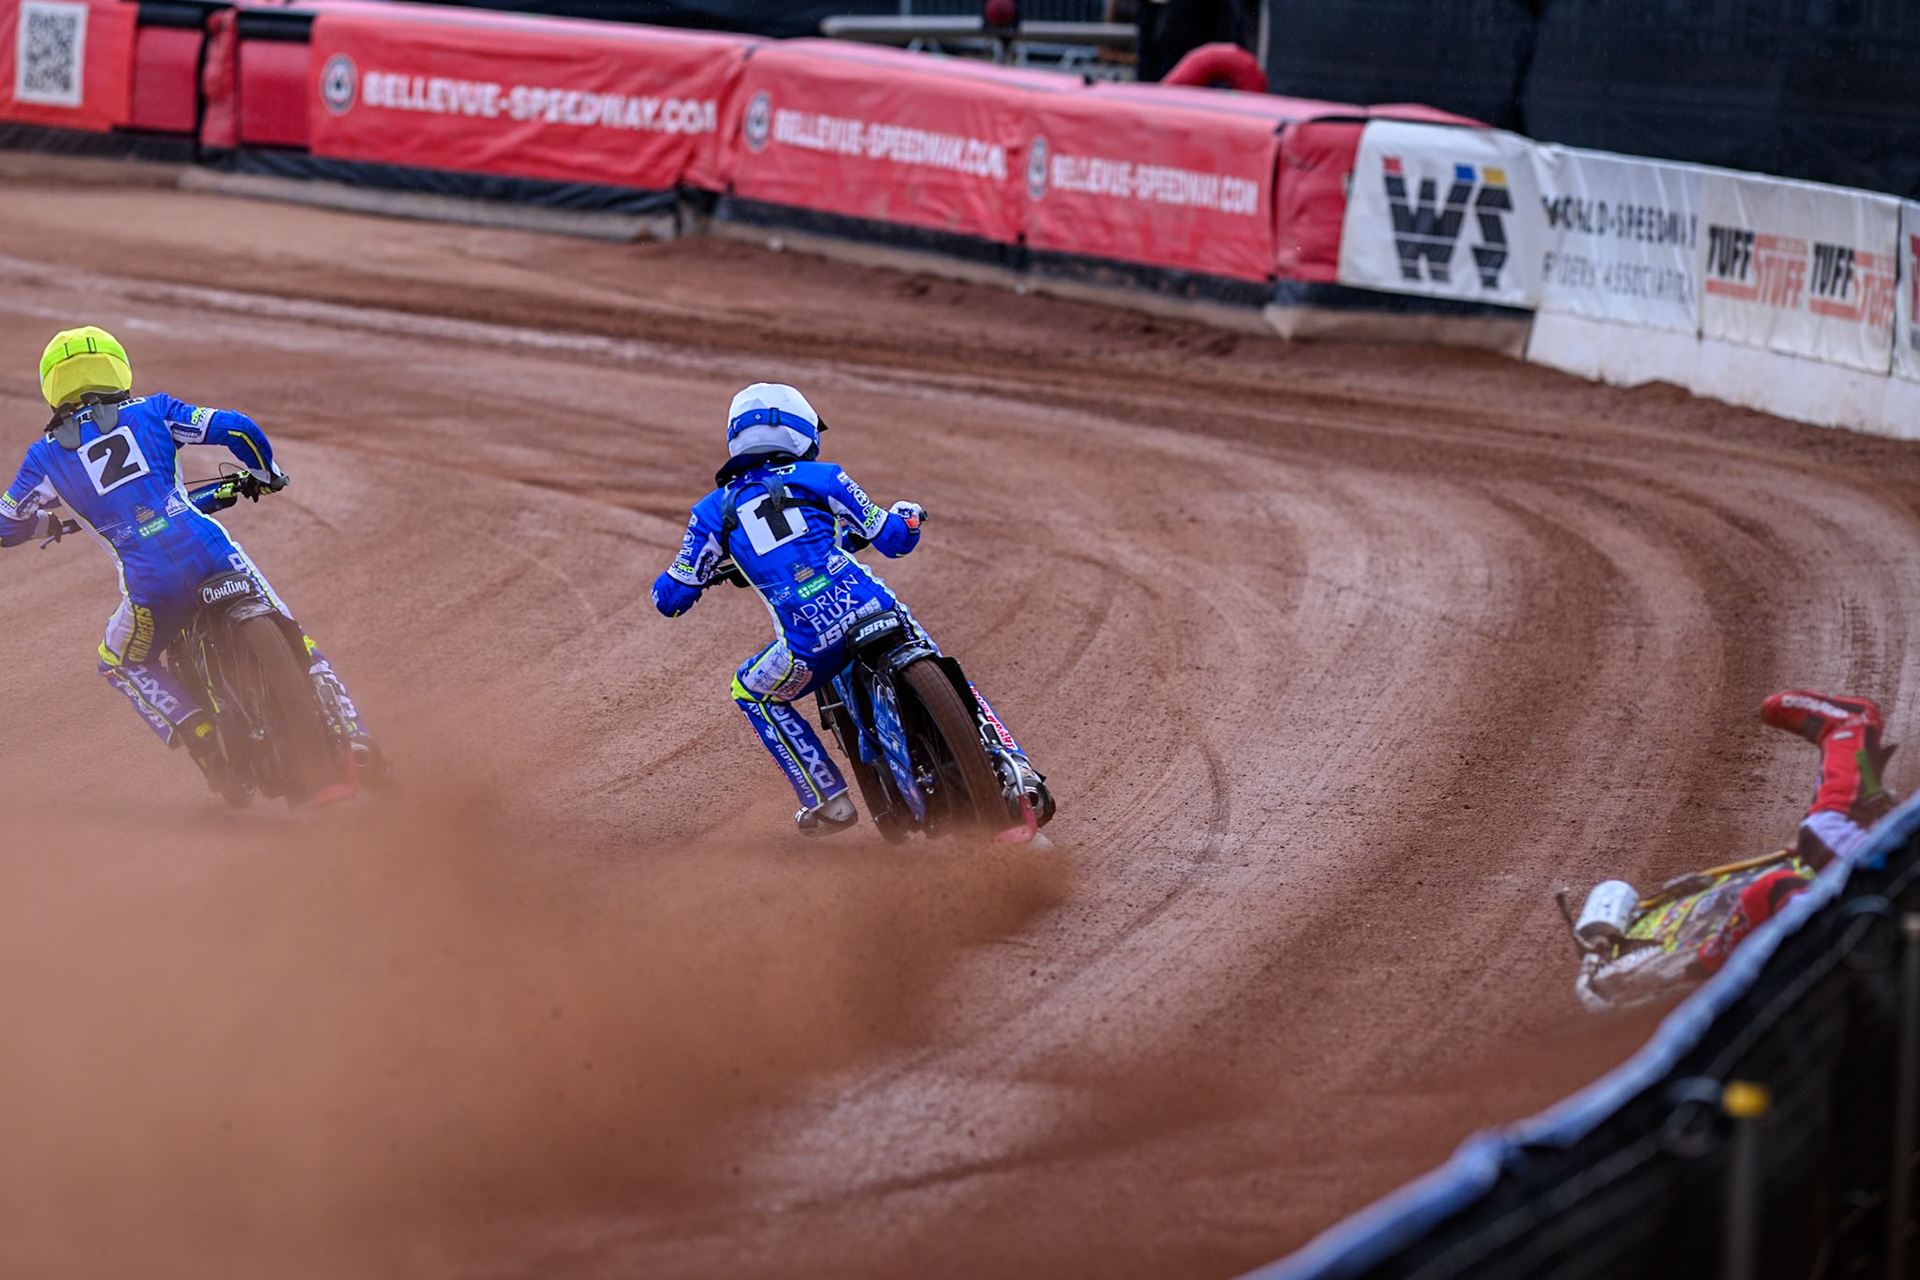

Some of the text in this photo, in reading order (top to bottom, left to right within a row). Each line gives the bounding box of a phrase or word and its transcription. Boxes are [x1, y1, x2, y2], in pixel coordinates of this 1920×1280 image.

[1051, 153, 1259, 217] BELLEVUE-SPEEDWAY.COM
[1706, 223, 1755, 280] TUFF
[1752, 231, 1808, 310] STUFF
[1811, 241, 1856, 299] TUFF
[87, 434, 142, 489] 2
[753, 494, 795, 542] 1
[202, 578, 251, 605] Clouting
[791, 573, 859, 627] ADRIAN
[809, 592, 859, 632] FLUX
[127, 603, 156, 663] CHARGERS
[811, 610, 858, 653] JSR
[855, 619, 885, 642] JSR
[770, 702, 837, 790] OXFOR
[775, 743, 815, 799] HARRISON
